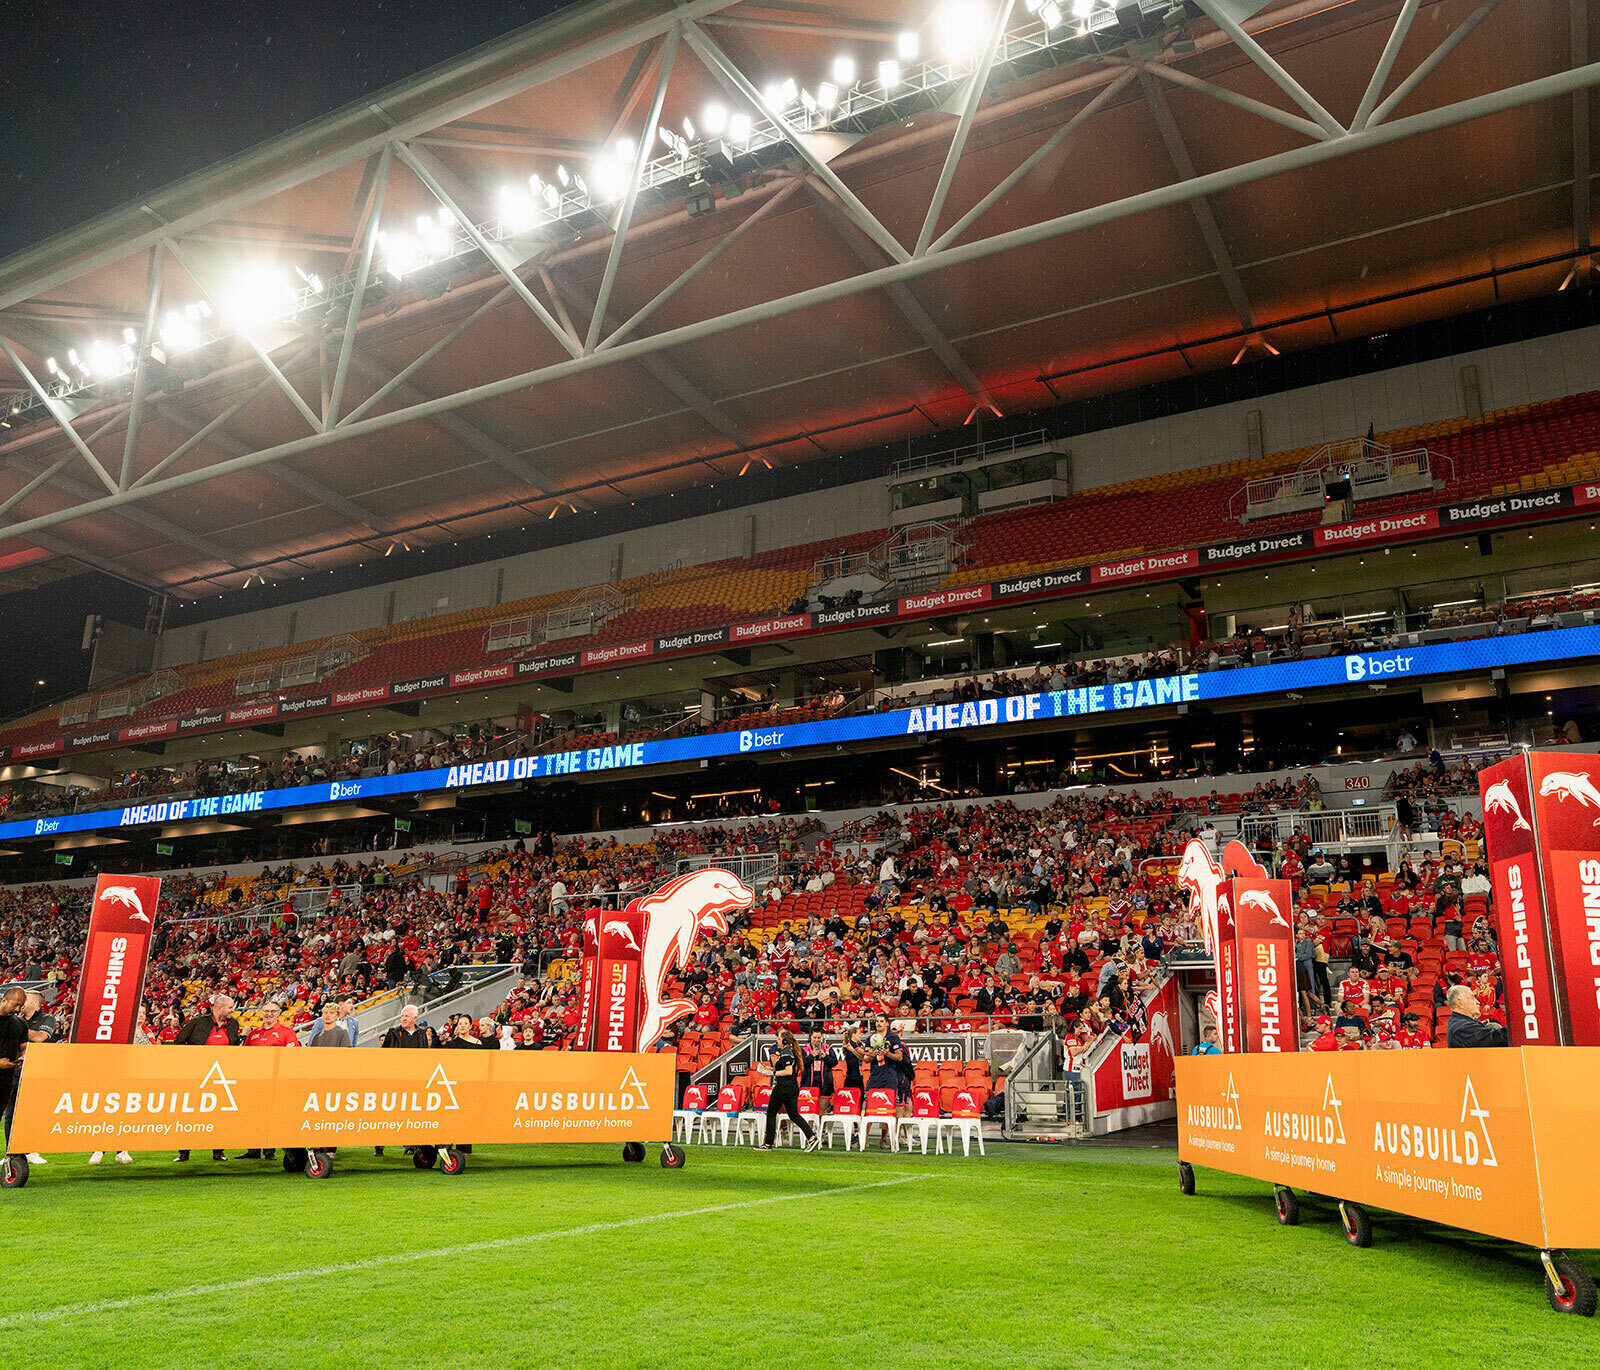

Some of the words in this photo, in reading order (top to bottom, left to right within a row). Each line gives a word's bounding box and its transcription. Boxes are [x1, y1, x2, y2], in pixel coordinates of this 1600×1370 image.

[1450, 501, 1506, 520] Budget
[1510, 492, 1561, 510] Direct
[1324, 524, 1377, 540] Budget
[1380, 514, 1426, 531] Direct
[1208, 543, 1256, 559] Budget
[1259, 535, 1302, 552] Direct
[1100, 561, 1145, 577] Budget
[1148, 554, 1188, 569] Direct
[1000, 579, 1042, 594] Budget
[1044, 572, 1082, 586] Direct
[906, 595, 945, 609] Budget
[948, 589, 982, 603] Direct
[818, 609, 855, 623] Budget
[858, 604, 890, 617] Direct
[736, 623, 771, 636] Budget
[773, 618, 803, 630] Direct
[659, 636, 692, 649] Budget
[694, 631, 722, 642] Direct
[588, 649, 617, 661] Budget
[620, 644, 646, 655] Direct
[519, 660, 548, 672] Budget
[550, 656, 575, 667] Direct
[1370, 655, 1413, 675] betr
[455, 671, 482, 682] Budget
[484, 667, 508, 678] Direct
[336, 692, 361, 702] Budget
[363, 688, 384, 698] Direct
[394, 682, 420, 693] Budget
[422, 678, 444, 688] Direct
[230, 709, 252, 719] Budget
[254, 706, 272, 716] Direct
[282, 702, 305, 712] Budget
[306, 698, 327, 707] Direct
[906, 699, 998, 734] AHEAD
[1006, 694, 1040, 722] OF
[1048, 686, 1105, 716] THE
[1113, 674, 1199, 709] GAME
[181, 718, 202, 728] Budget
[755, 730, 784, 747] betr
[446, 761, 509, 788] AHEAD
[514, 756, 539, 778] OF
[543, 750, 580, 776] THE
[586, 743, 644, 771] GAME
[341, 783, 362, 796] betr
[1346, 777, 1369, 789] 340
[120, 803, 166, 826] AHEAD
[169, 800, 190, 820] OF
[192, 796, 220, 818] THE
[222, 791, 264, 814] GAME
[43, 820, 60, 833] betr
[1257, 943, 1271, 966] UP
[1508, 864, 1539, 1040] DOLPHINS
[612, 963, 622, 982] UP
[96, 937, 127, 1040] DOLPHINS
[608, 983, 626, 1050] PHINS
[1258, 967, 1281, 1052] PHINS
[909, 1046, 958, 1062] WAHL
[1123, 1050, 1148, 1074] Budget
[730, 1064, 748, 1072] WAHL
[1127, 1070, 1149, 1092] Direct
[53, 1092, 217, 1114] AUSBUILD
[303, 1092, 441, 1112] AUSBUILD
[515, 1092, 634, 1110] AUSBUILD
[300, 1120, 311, 1131] A
[314, 1119, 355, 1133] simple
[357, 1119, 403, 1132] journey
[406, 1118, 439, 1130] home
[513, 1118, 522, 1128] A
[525, 1117, 560, 1129] simple
[561, 1117, 601, 1129] journey
[604, 1117, 632, 1127] home
[1188, 1104, 1235, 1130] AUSBUILD
[51, 1122, 62, 1134] A
[66, 1121, 114, 1136] simple
[117, 1122, 172, 1136] journey
[175, 1121, 214, 1133] home
[1264, 1111, 1334, 1145] AUSBUILD
[1374, 1121, 1479, 1166] AUSBUILD
[1265, 1146, 1270, 1159] A
[1271, 1147, 1291, 1165] simple
[1291, 1152, 1315, 1172] journey
[1316, 1154, 1336, 1172] home
[1376, 1164, 1383, 1181] A
[1384, 1166, 1412, 1190] simple
[1414, 1171, 1450, 1199] journey
[1452, 1177, 1483, 1201] home
